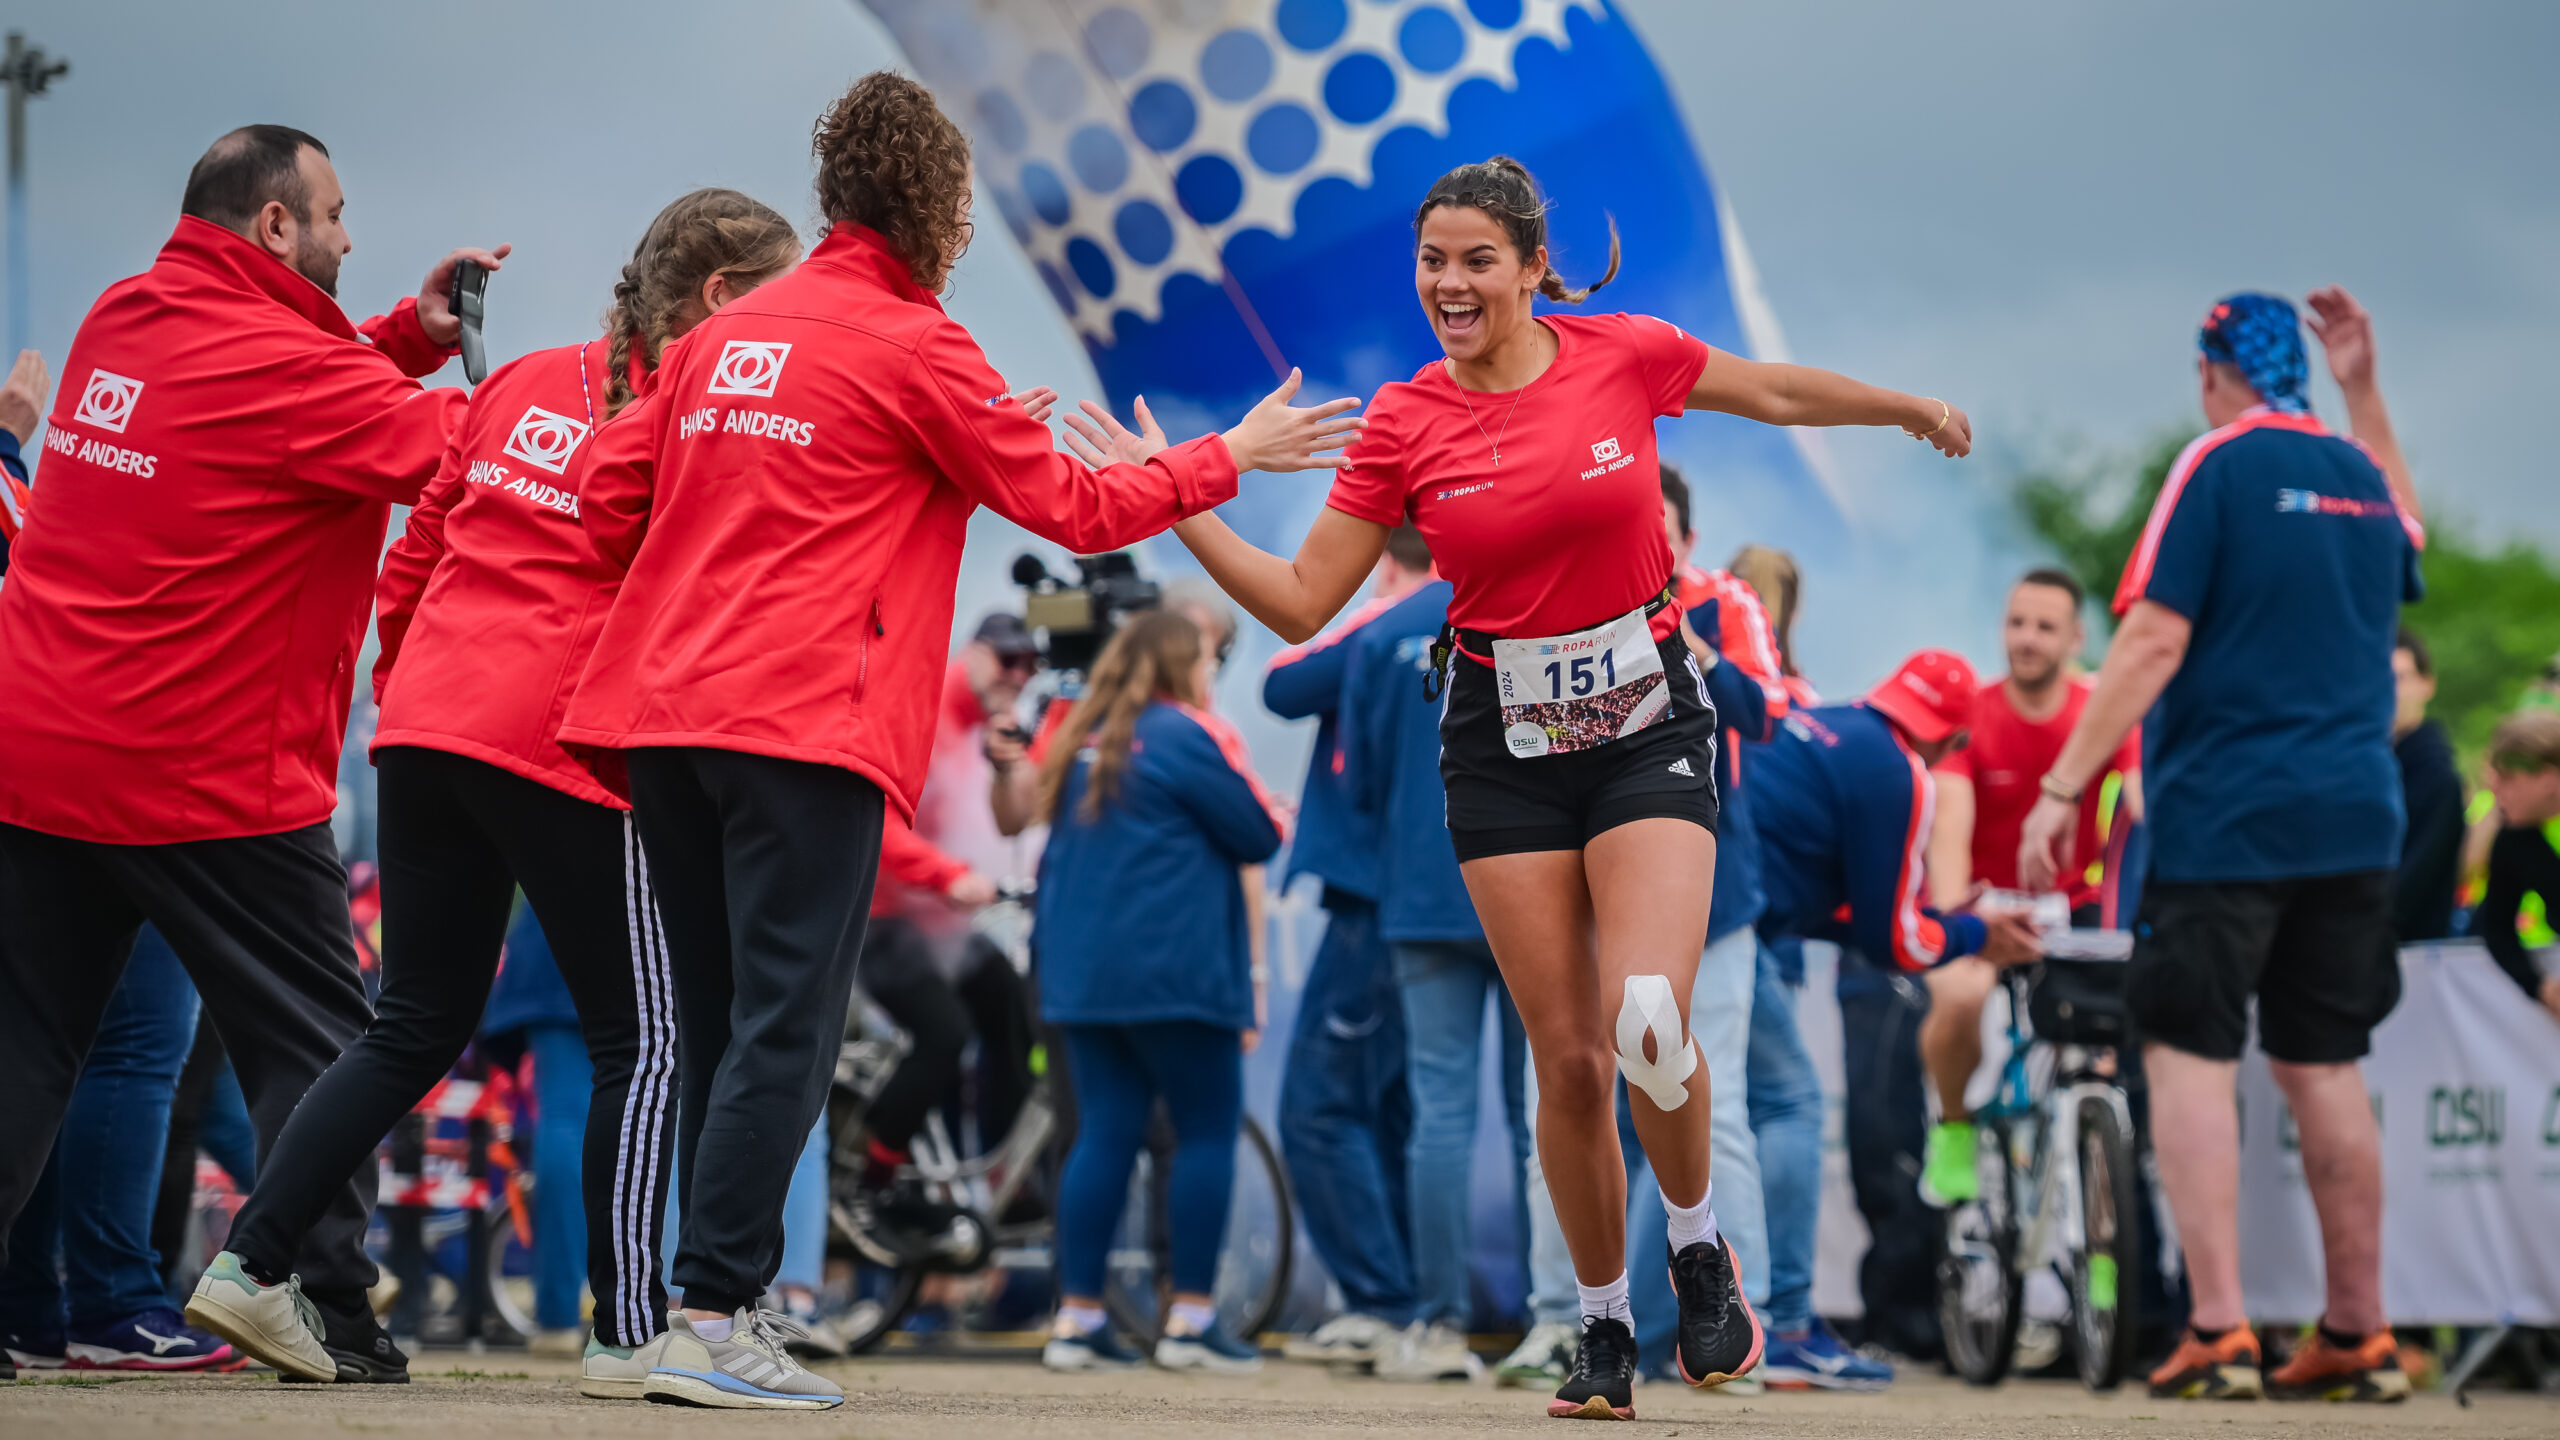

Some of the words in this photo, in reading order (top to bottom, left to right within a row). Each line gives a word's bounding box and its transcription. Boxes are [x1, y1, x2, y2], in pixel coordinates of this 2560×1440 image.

[680, 407, 718, 440] HANS
[722, 408, 816, 447] ANDERS
[45, 425, 79, 456] HANS
[77, 438, 159, 479] ANDERS
[1580, 465, 1607, 481] HANS
[1608, 453, 1635, 473] ANDERS
[466, 460, 510, 486] HANS
[503, 476, 580, 519] ANDER
[1453, 481, 1494, 497] ROPARUN
[1562, 628, 1617, 653] ROPARUN
[1501, 670, 1514, 699] 2024
[1544, 647, 1616, 700] 151
[1512, 736, 1538, 747] DSW
[1668, 765, 1695, 777] adidas
